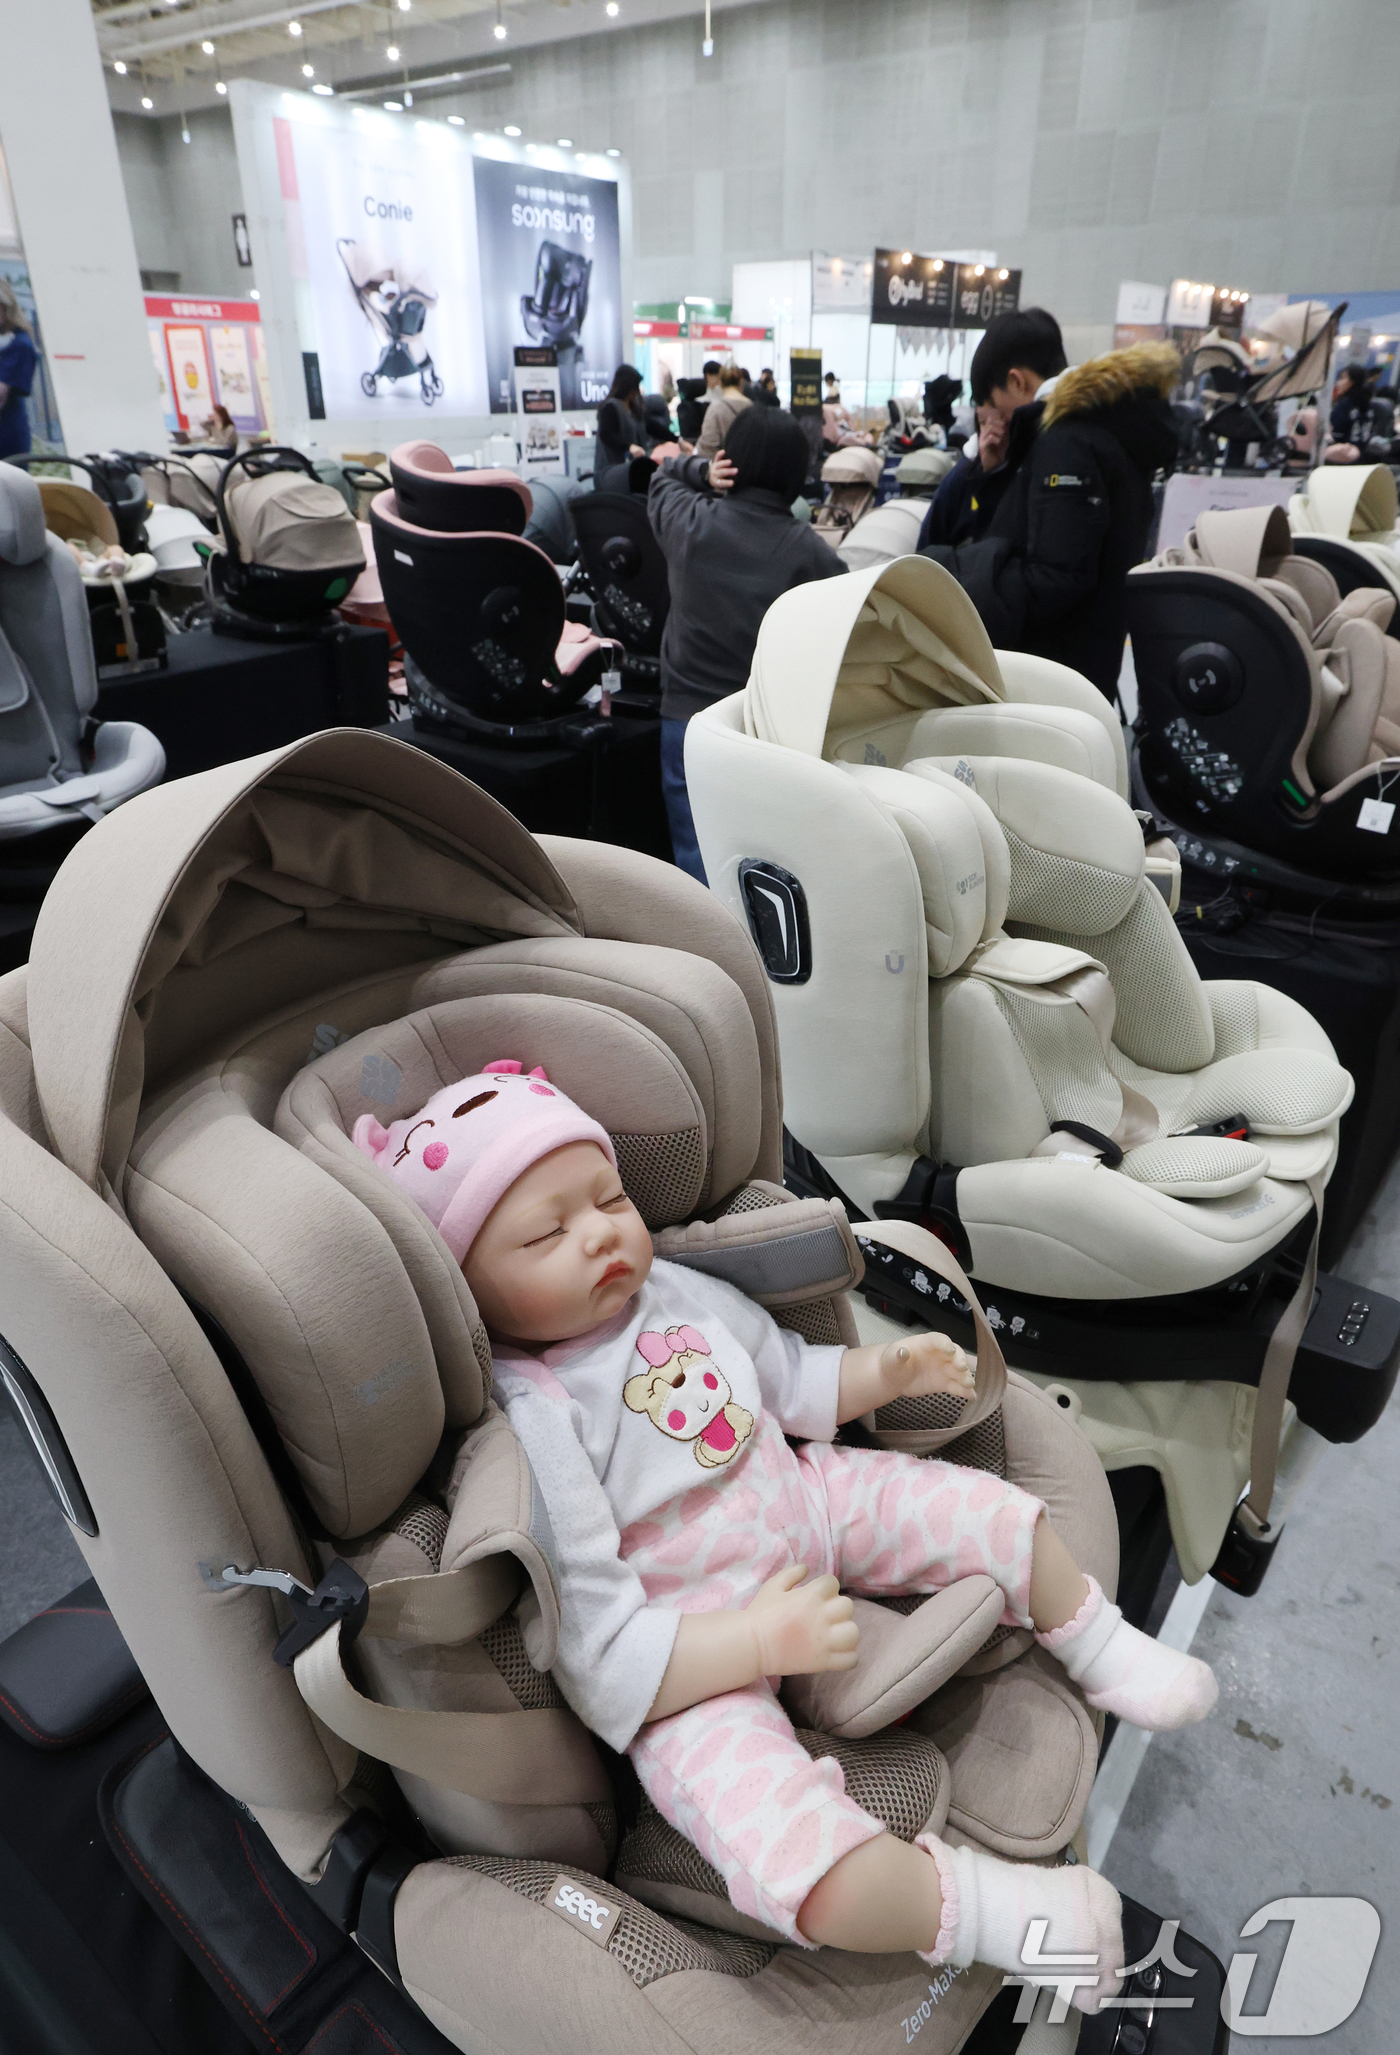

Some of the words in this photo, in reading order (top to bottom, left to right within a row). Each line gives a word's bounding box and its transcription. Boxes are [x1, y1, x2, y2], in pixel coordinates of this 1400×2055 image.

[364, 196, 413, 222] Conie
[511, 203, 596, 243] soonsung
[554, 1884, 611, 1930] seec
